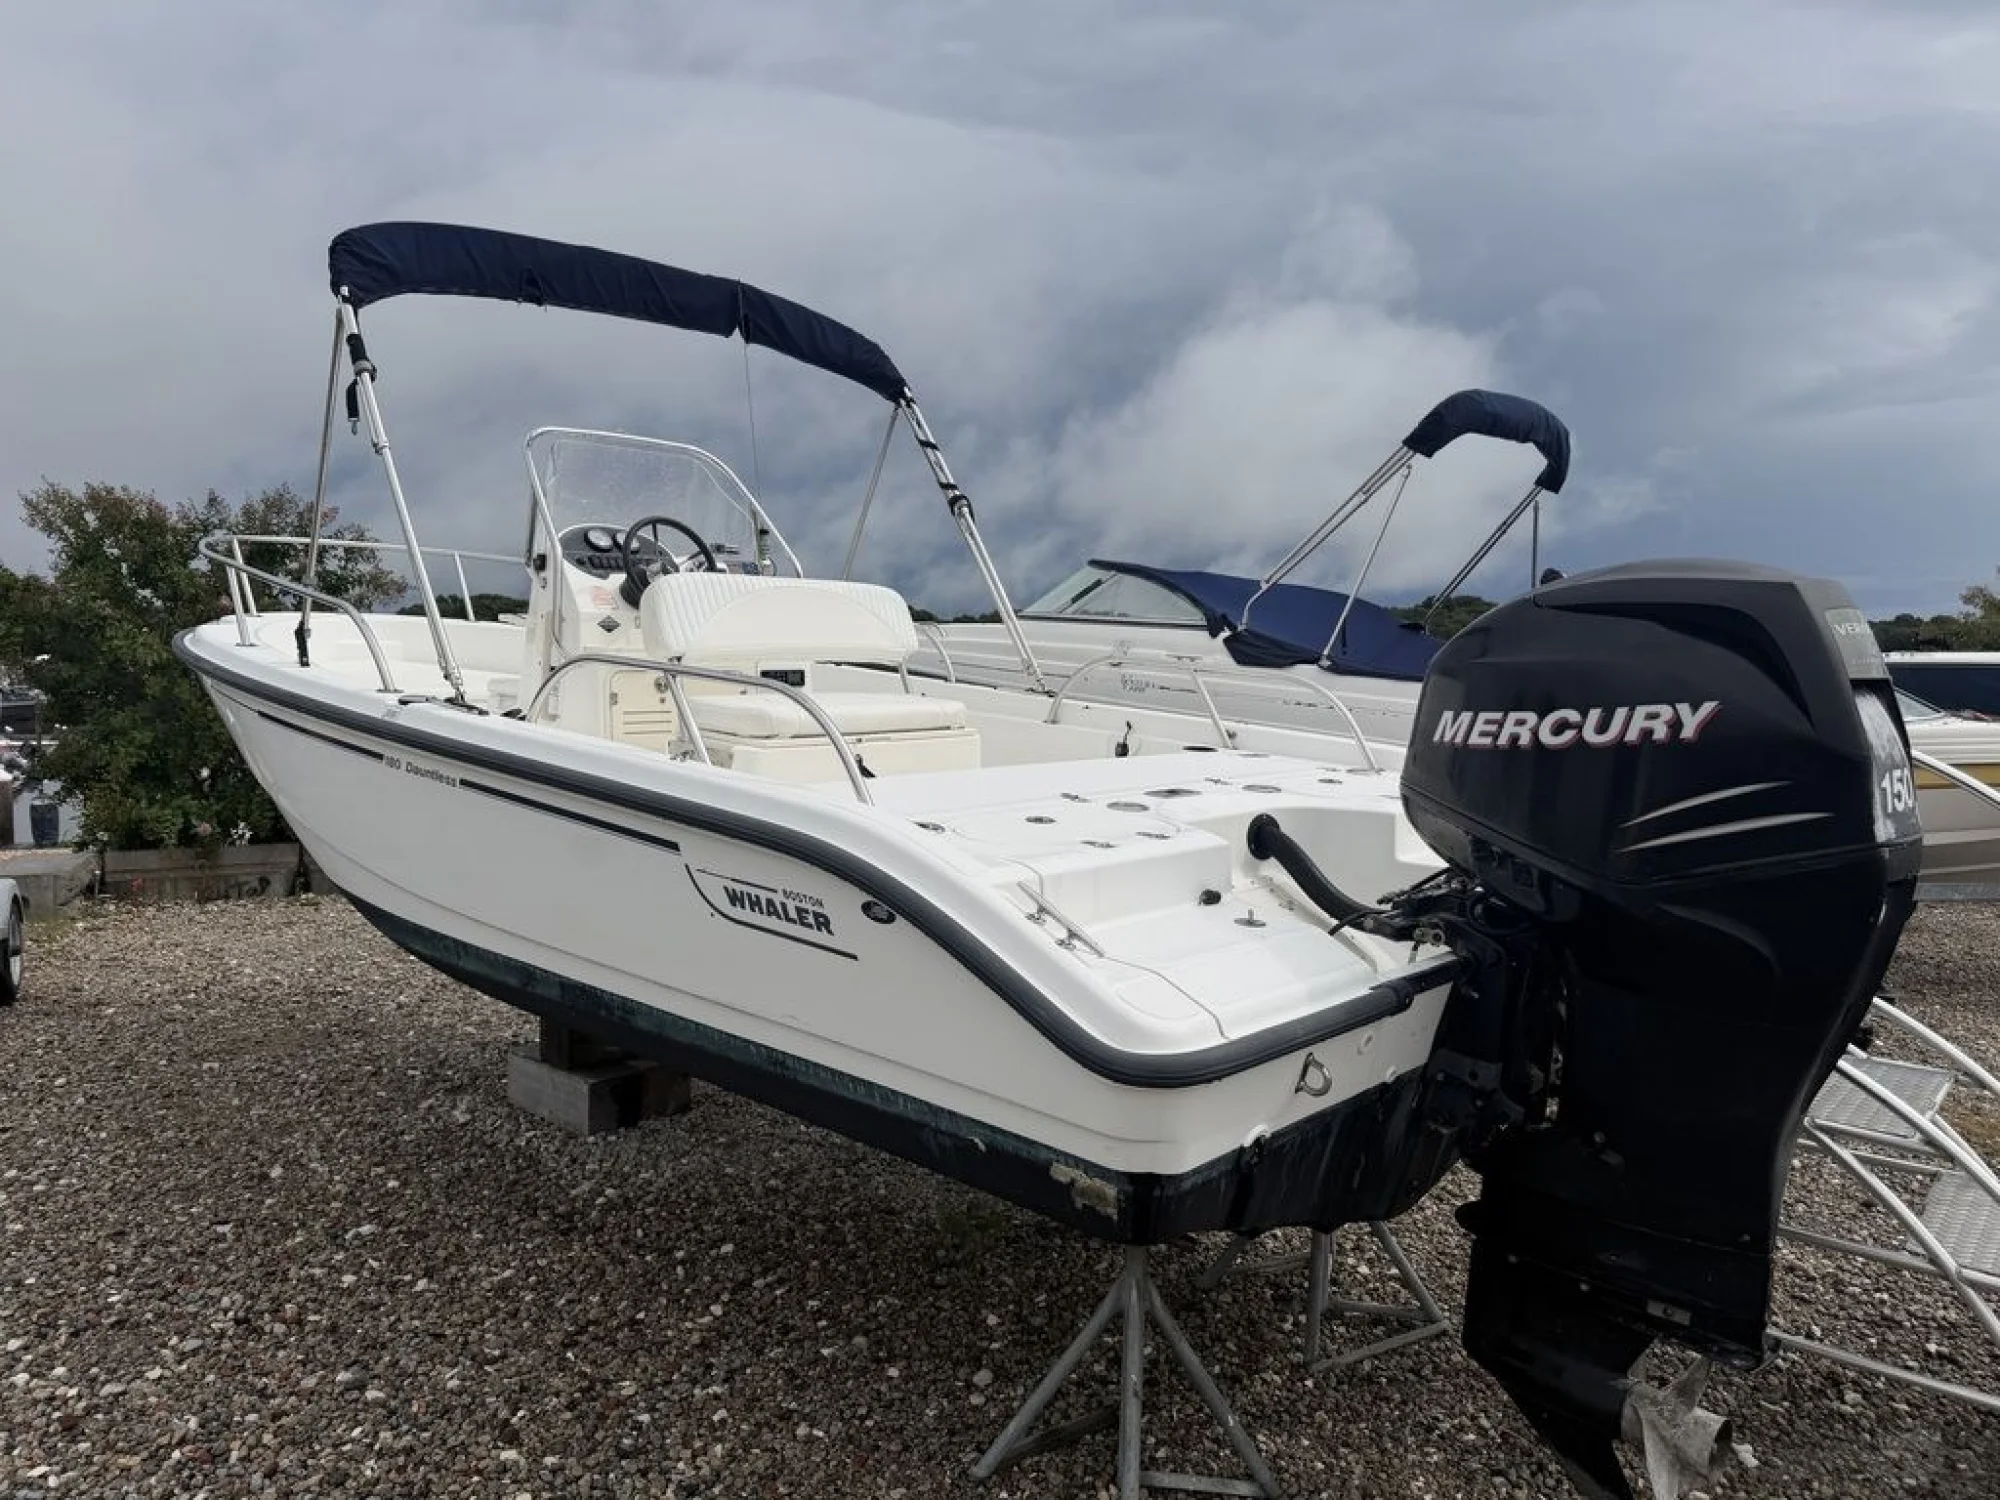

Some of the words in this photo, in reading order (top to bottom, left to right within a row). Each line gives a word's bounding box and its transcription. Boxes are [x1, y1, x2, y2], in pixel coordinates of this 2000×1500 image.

[1432, 700, 1720, 750] MERCURY
[405, 761, 457, 788] Dauntless
[722, 883, 835, 937] WHALER
[782, 887, 825, 909] BOSTON
